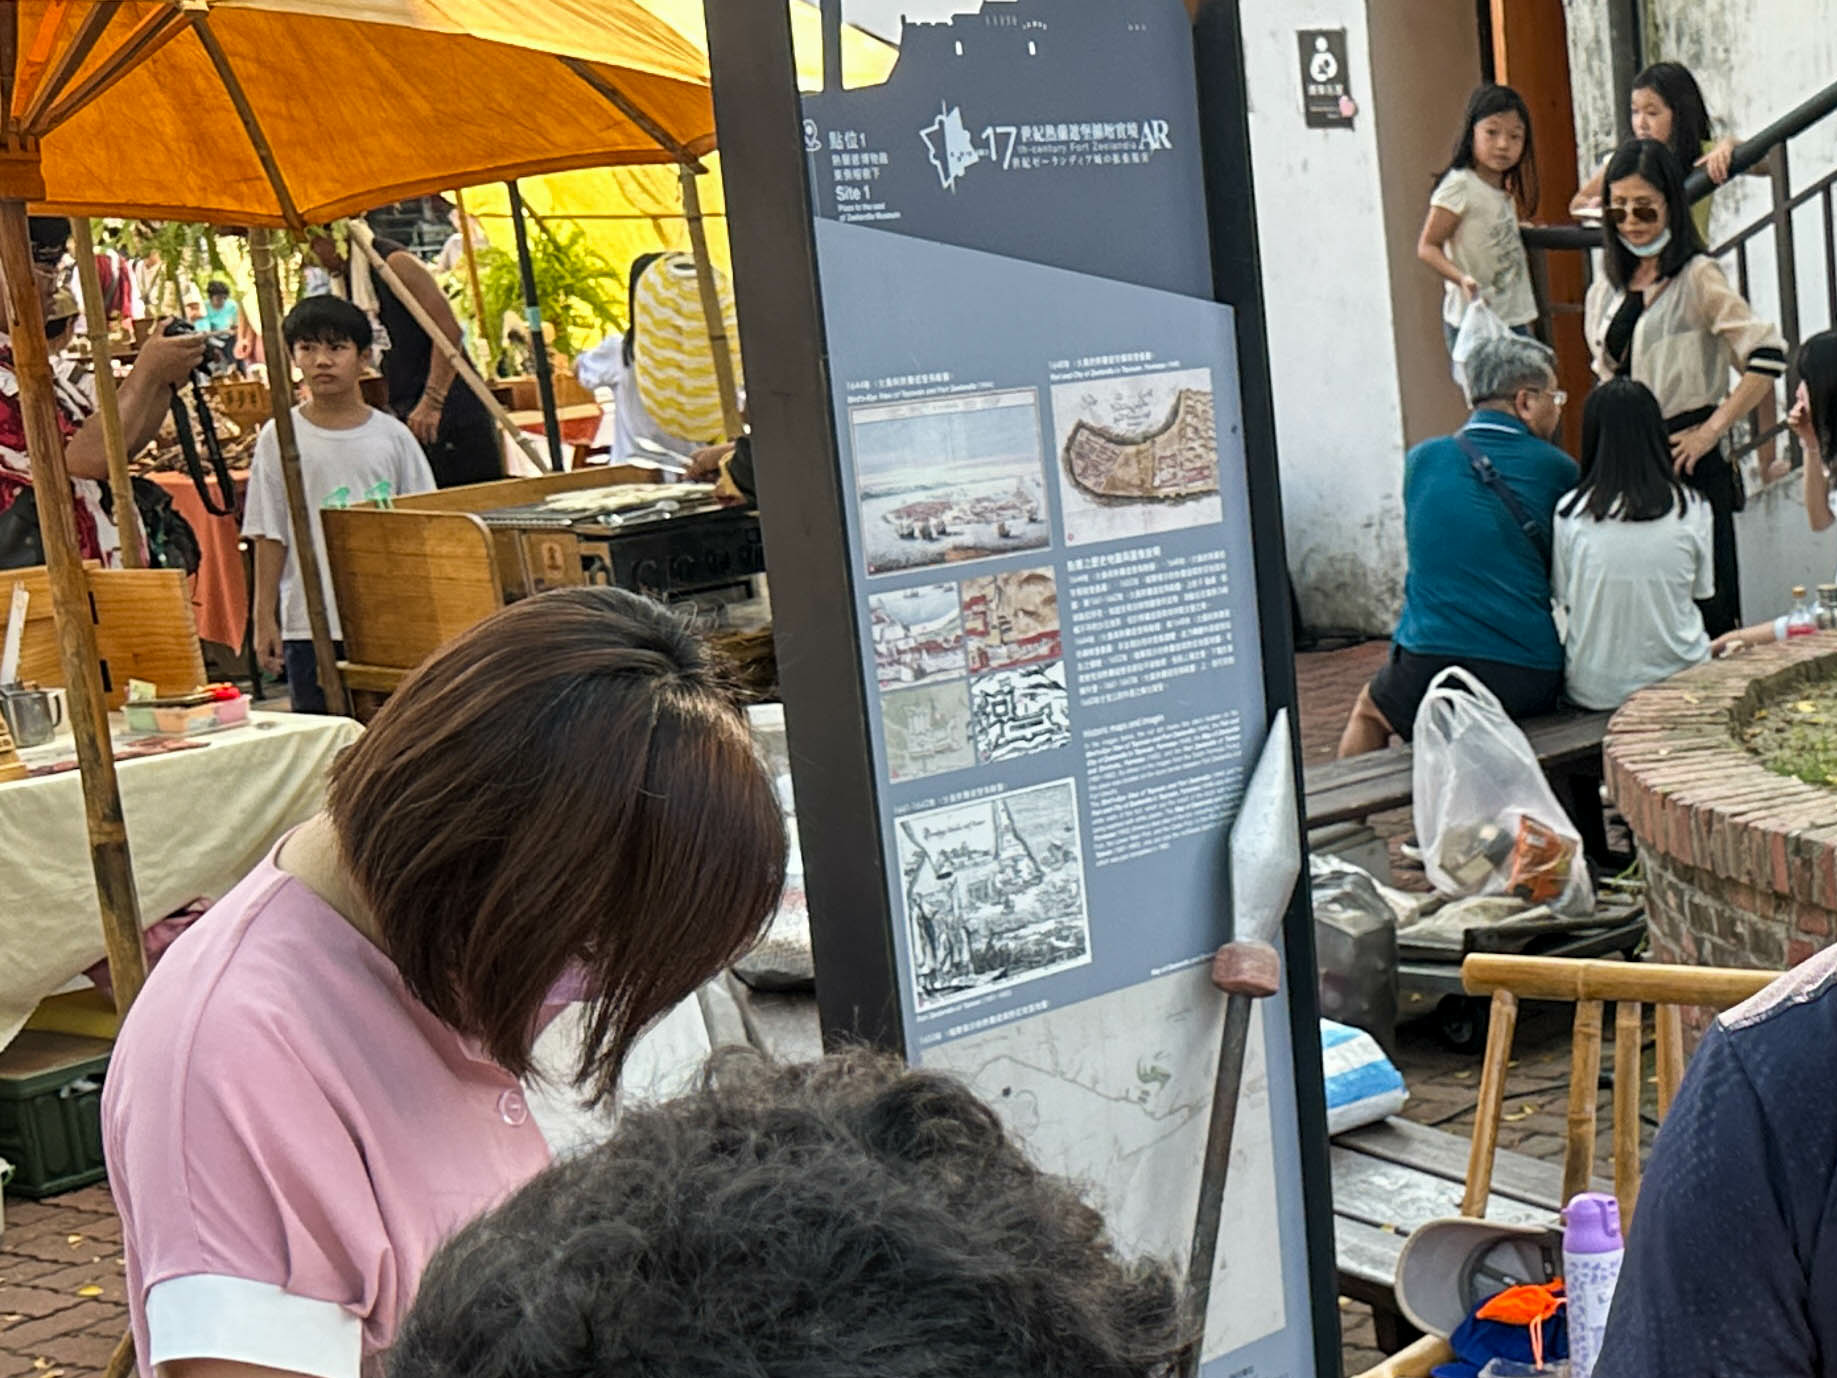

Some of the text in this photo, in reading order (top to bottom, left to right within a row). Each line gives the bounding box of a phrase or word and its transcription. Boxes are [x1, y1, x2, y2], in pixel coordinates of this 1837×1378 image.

[1139, 119, 1173, 151] AR
[836, 184, 871, 201] Site 1
